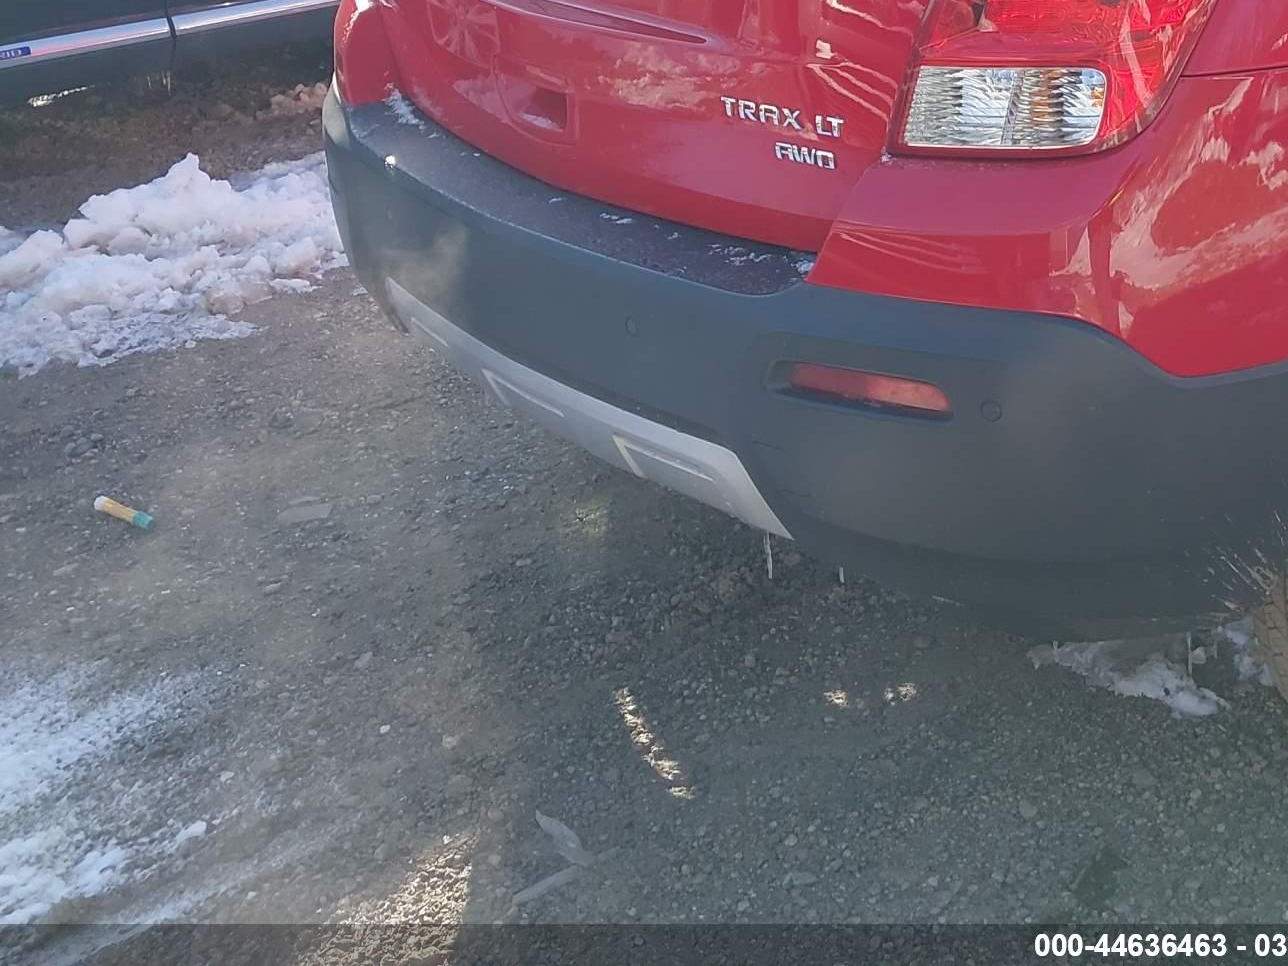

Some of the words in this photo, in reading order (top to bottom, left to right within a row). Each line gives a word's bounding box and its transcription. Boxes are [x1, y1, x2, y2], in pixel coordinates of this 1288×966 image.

[720, 96, 800, 130] TRAX
[815, 115, 843, 137] LT
[775, 142, 835, 169] AWD
